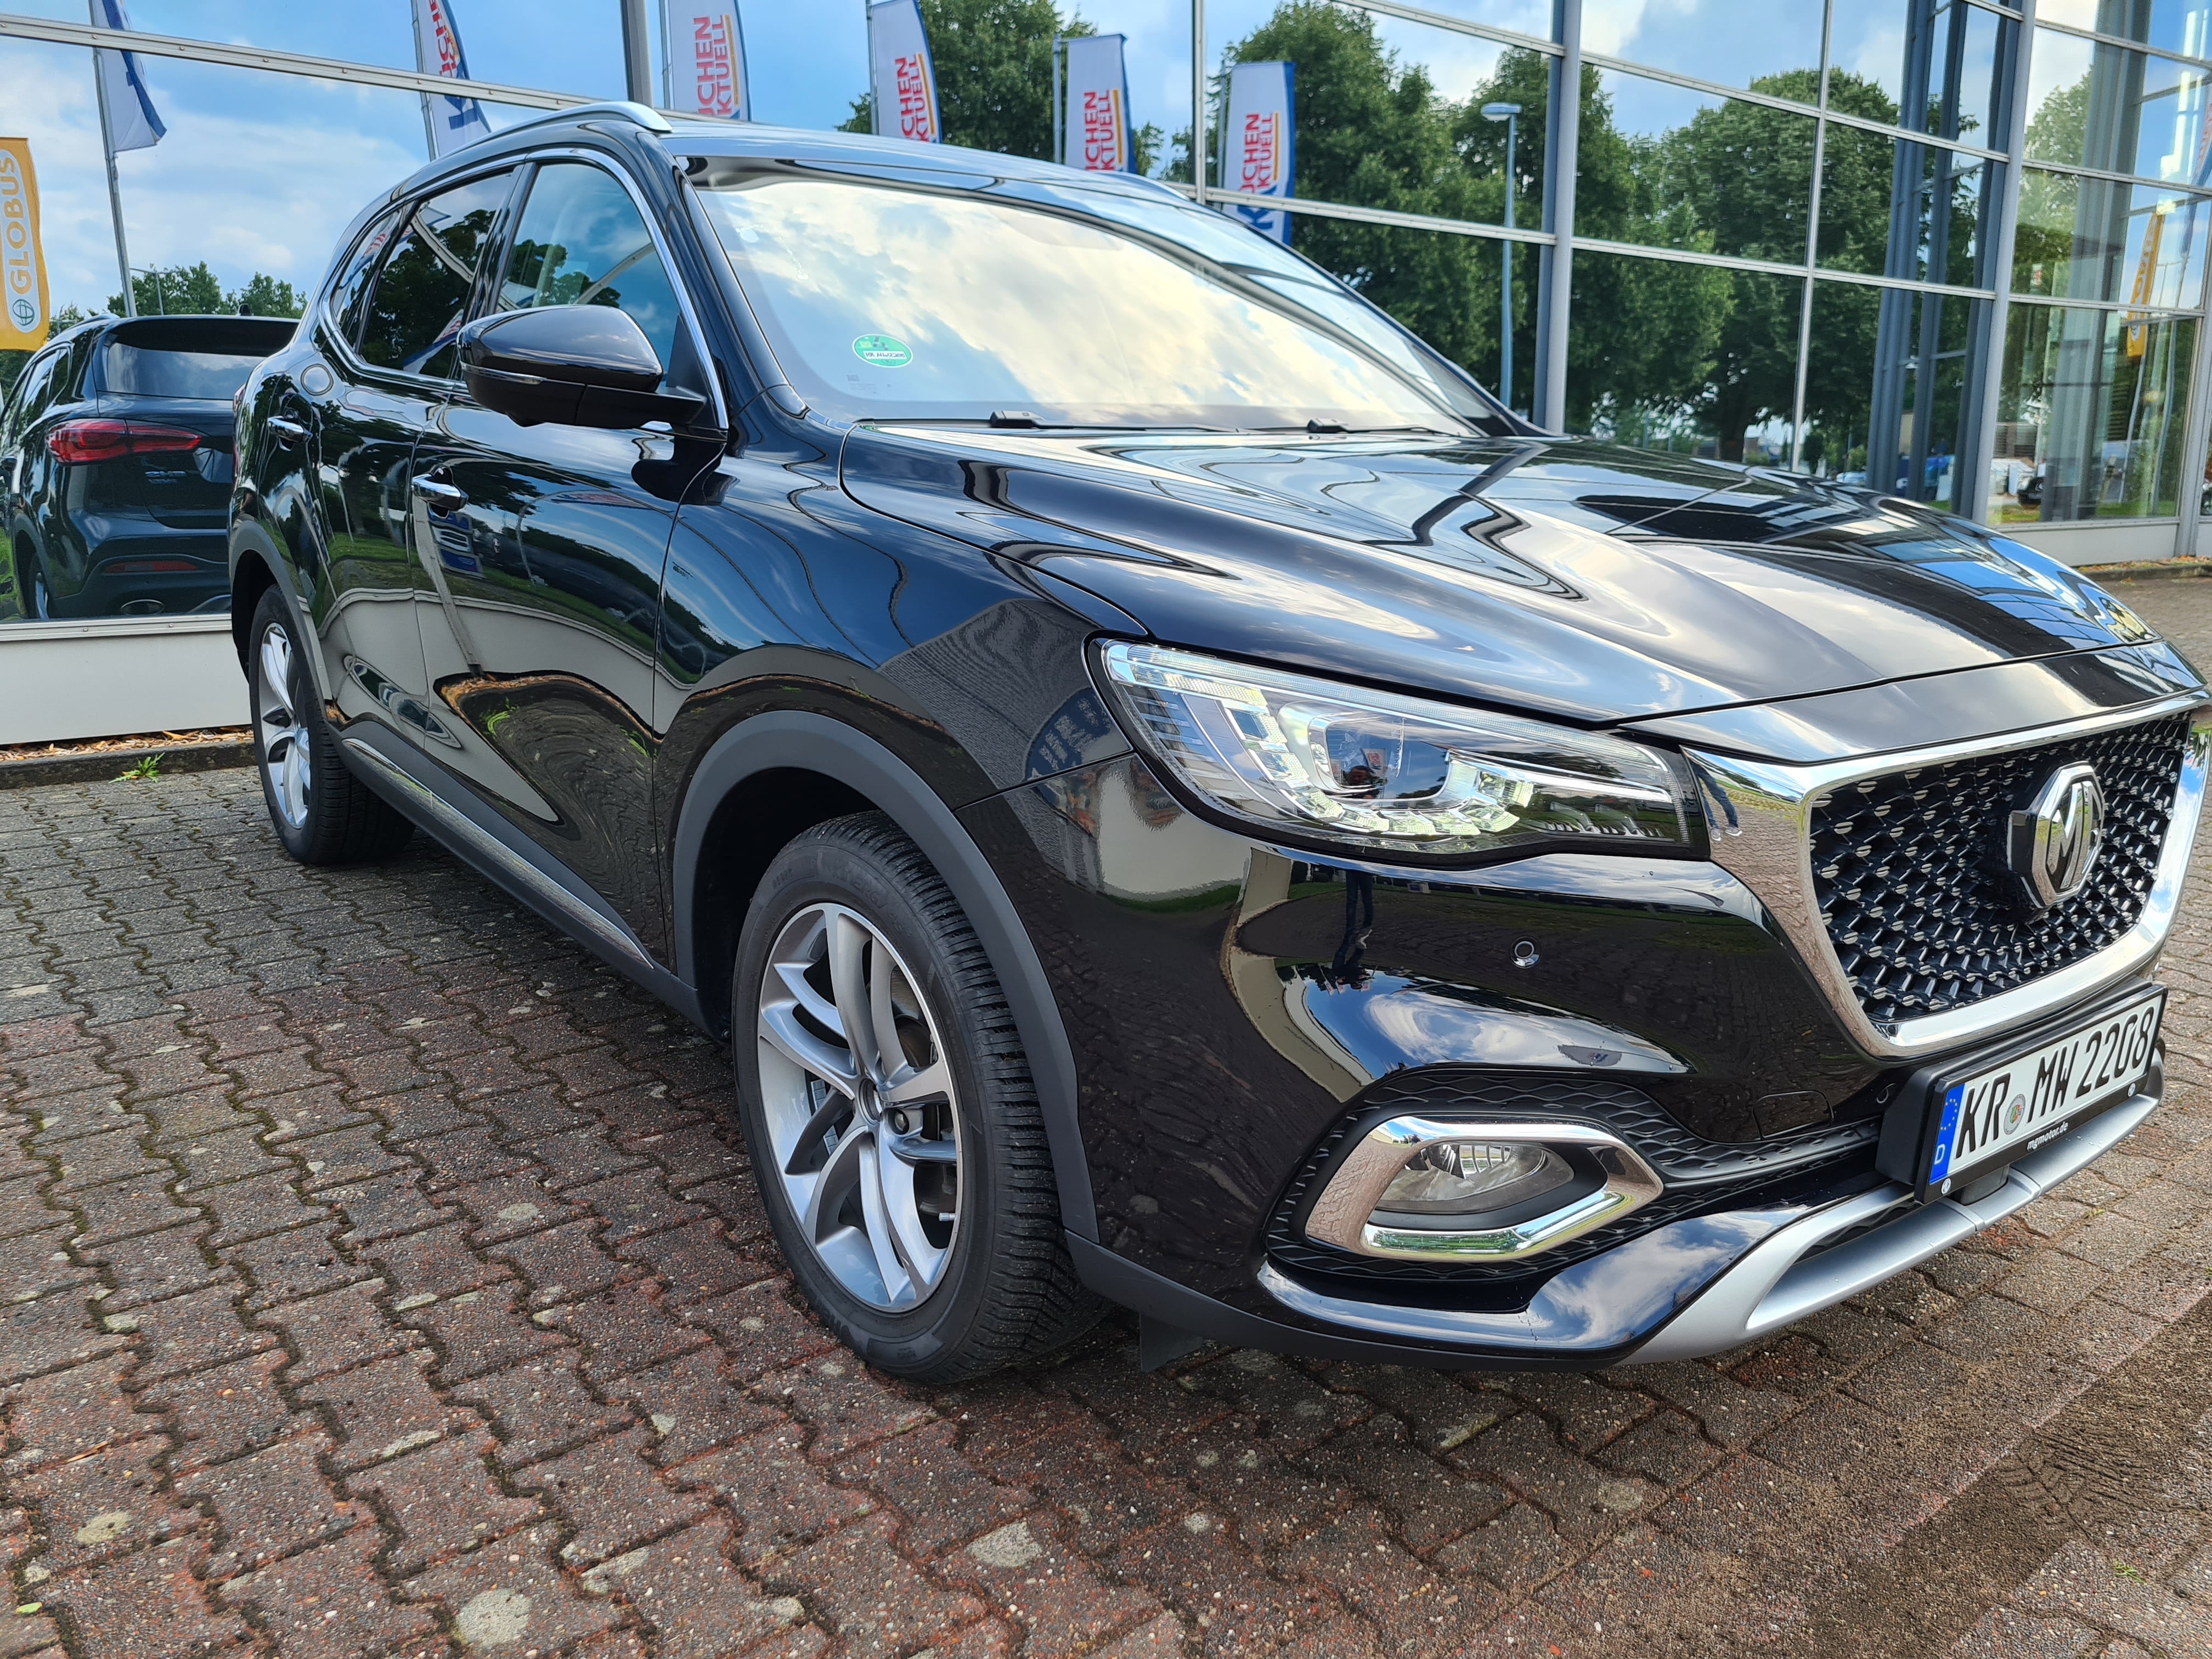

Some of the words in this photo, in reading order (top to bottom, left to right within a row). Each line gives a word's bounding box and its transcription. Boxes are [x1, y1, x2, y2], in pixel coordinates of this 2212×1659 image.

[0, 157, 32, 295] GLOBUS
[1956, 1073, 2011, 1159] KR
[2027, 1121, 2069, 1150] mgmotor.de
[1934, 1144, 1945, 1165] D
